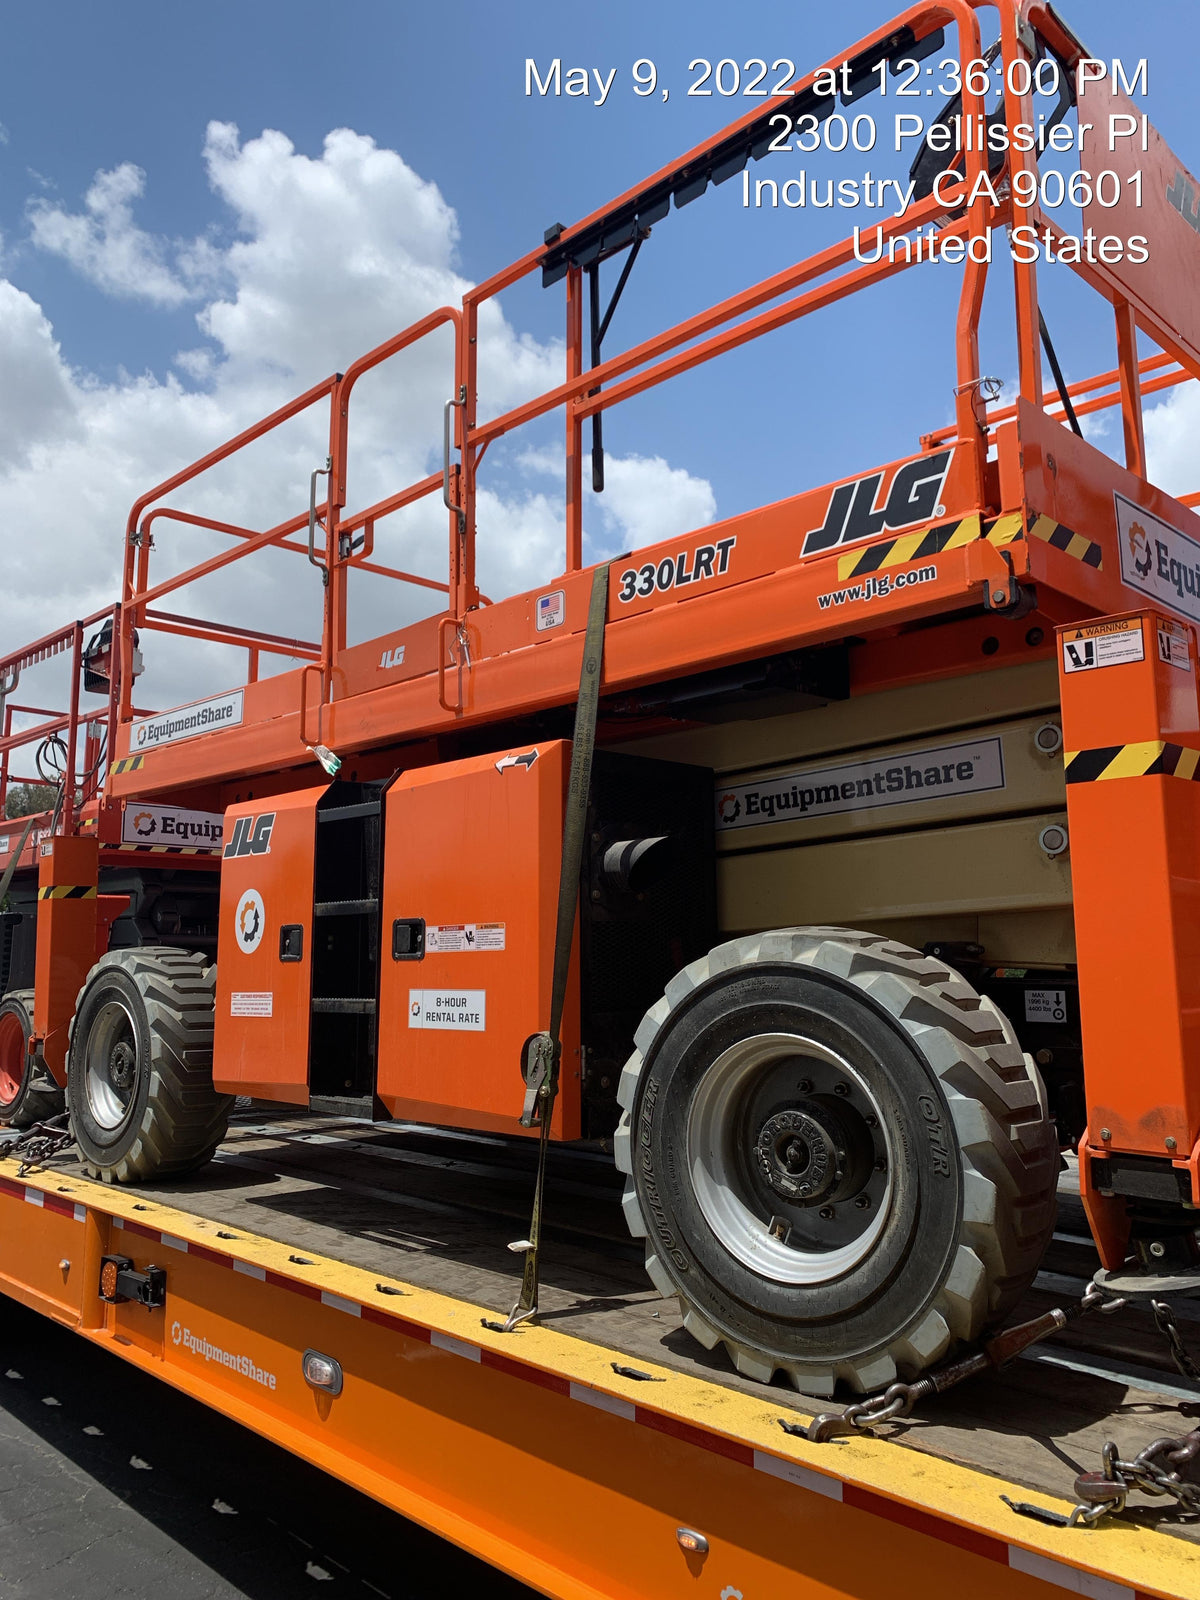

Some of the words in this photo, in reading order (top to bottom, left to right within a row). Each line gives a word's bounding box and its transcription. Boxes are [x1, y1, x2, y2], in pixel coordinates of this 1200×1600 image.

[799, 447, 956, 558] JLG
[618, 536, 737, 602] 330LRT
[817, 565, 937, 609] www.jlg.com
[1085, 621, 1129, 636] WARNING
[147, 704, 233, 742] EquipmentShare
[745, 760, 974, 817] EquipmentShare
[223, 812, 277, 860] JLG
[425, 1012, 456, 1022] RENTAL
[458, 1012, 480, 1023] RATE
[435, 997, 467, 1008] 8-HOUR
[182, 1327, 277, 1391] EquipmentShare
